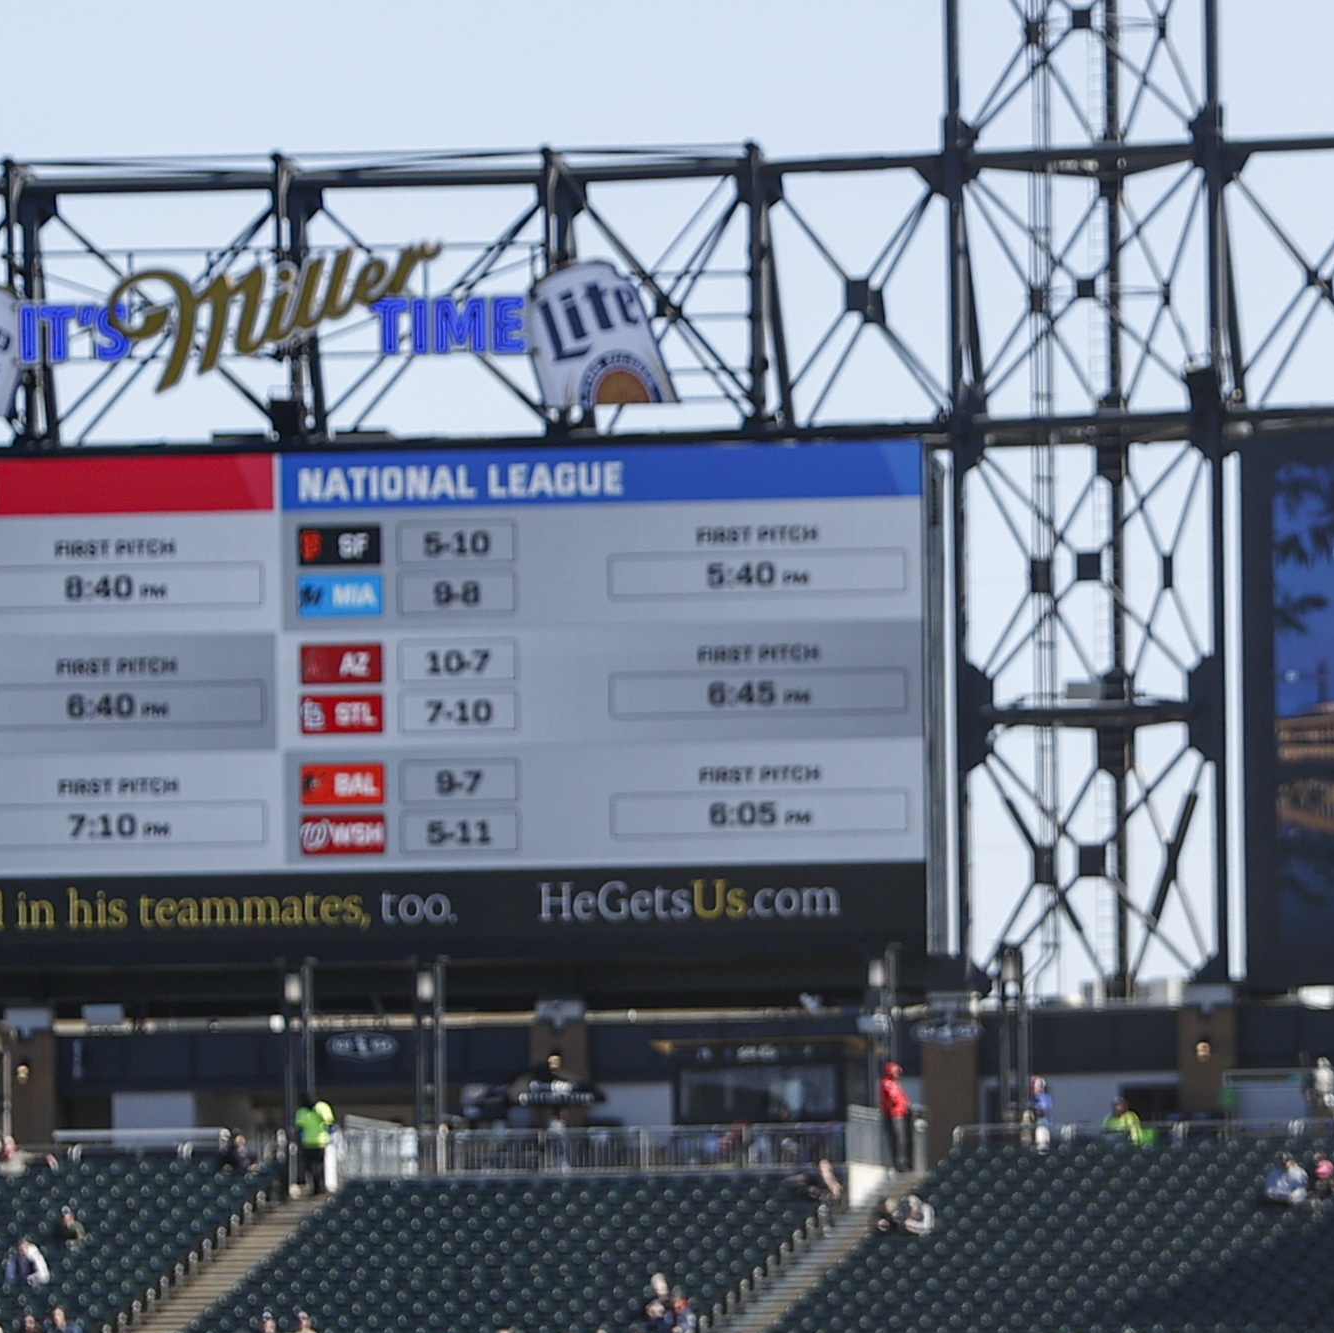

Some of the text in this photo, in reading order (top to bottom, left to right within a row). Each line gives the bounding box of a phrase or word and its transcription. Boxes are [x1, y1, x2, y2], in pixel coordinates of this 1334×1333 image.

[19, 242, 526, 394] IT'S Miller TIME
[540, 283, 640, 361] Lite
[297, 461, 624, 502] NATIONAL LEAGUE
[338, 533, 369, 559] SF
[425, 530, 490, 557] 5-10
[697, 524, 818, 544] FIRST PITCH
[55, 539, 176, 557] FIRST PITCH
[65, 574, 167, 599] 8:40 PM
[707, 562, 808, 589] 5:40 PM
[332, 580, 480, 608] MIA 9-8
[57, 657, 178, 676] FIRST PITCH
[339, 649, 490, 677] AZ 10-7
[697, 644, 819, 663] FIRST PITCH
[67, 694, 169, 719] 6:40 PM
[708, 680, 810, 708] 6:45 PM
[335, 702, 377, 727] STL
[427, 700, 491, 723] 7-10
[58, 777, 179, 795] FIRST PITCH
[334, 770, 483, 797] BAL 9-7
[698, 765, 821, 784] FIRST PITCH
[69, 814, 169, 839] 7:10 PM
[709, 802, 811, 828] 6:05 PM
[427, 819, 490, 845] 5-11
[16, 890, 55, 930] in
[66, 887, 128, 929] his
[139, 890, 371, 931] teammates,
[381, 890, 458, 926] too.
[537, 878, 841, 923] HeGetsUs.com
